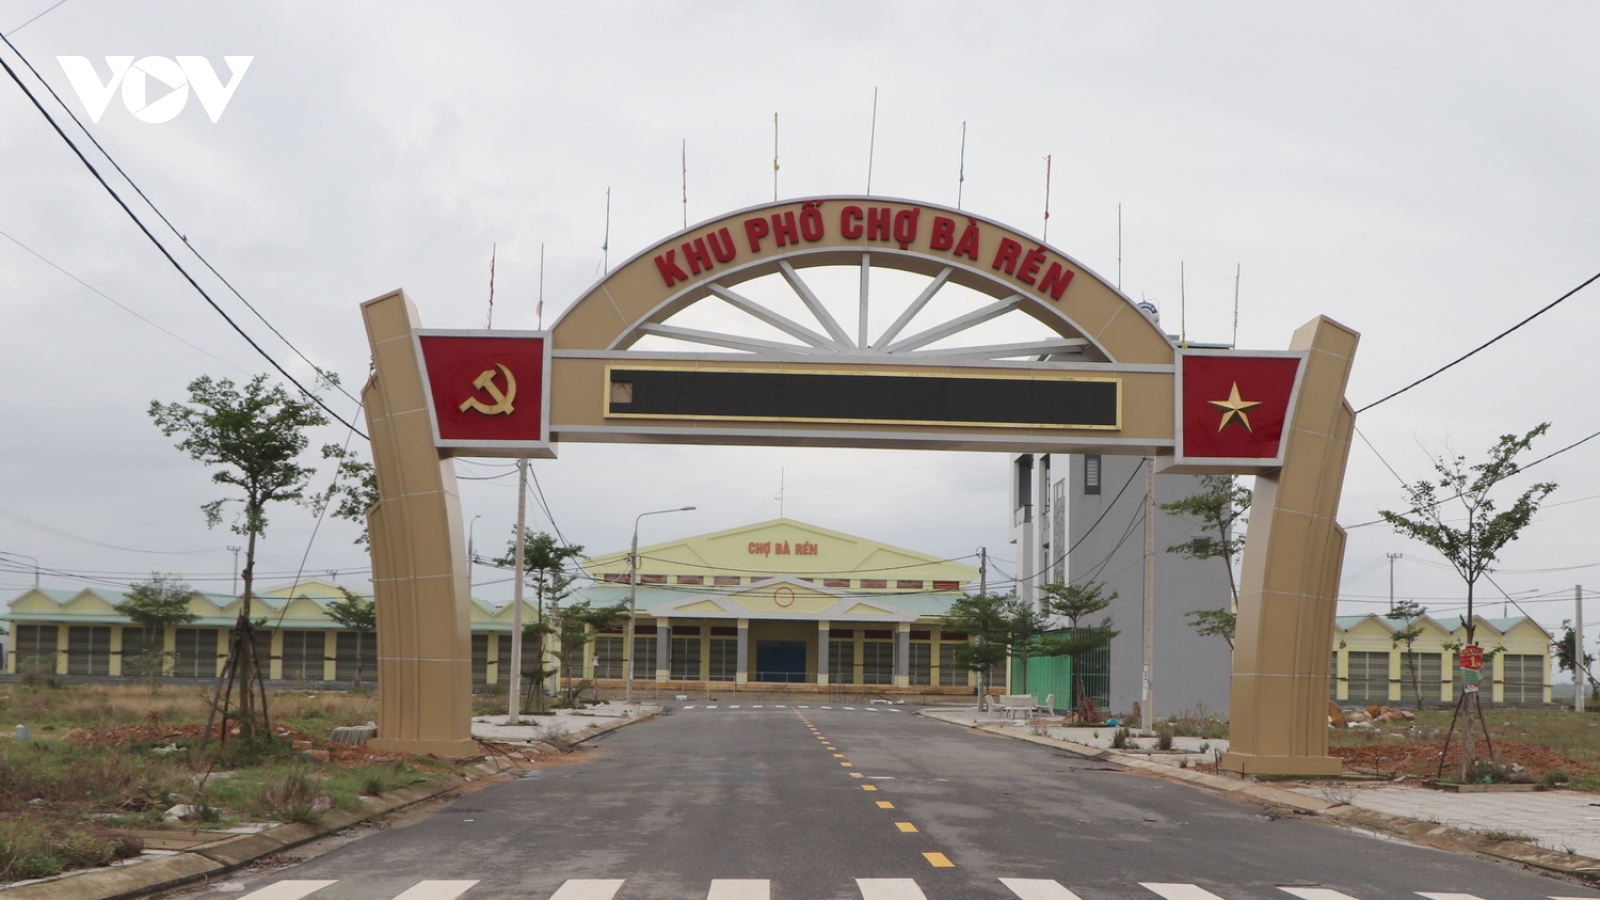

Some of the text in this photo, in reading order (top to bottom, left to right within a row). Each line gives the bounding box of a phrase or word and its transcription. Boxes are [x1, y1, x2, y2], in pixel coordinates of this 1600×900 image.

[654, 200, 1075, 300] KHU PHỐ CHỢ BÀ RÉN
[747, 539, 818, 558] CHỢ BÀ RÉN
